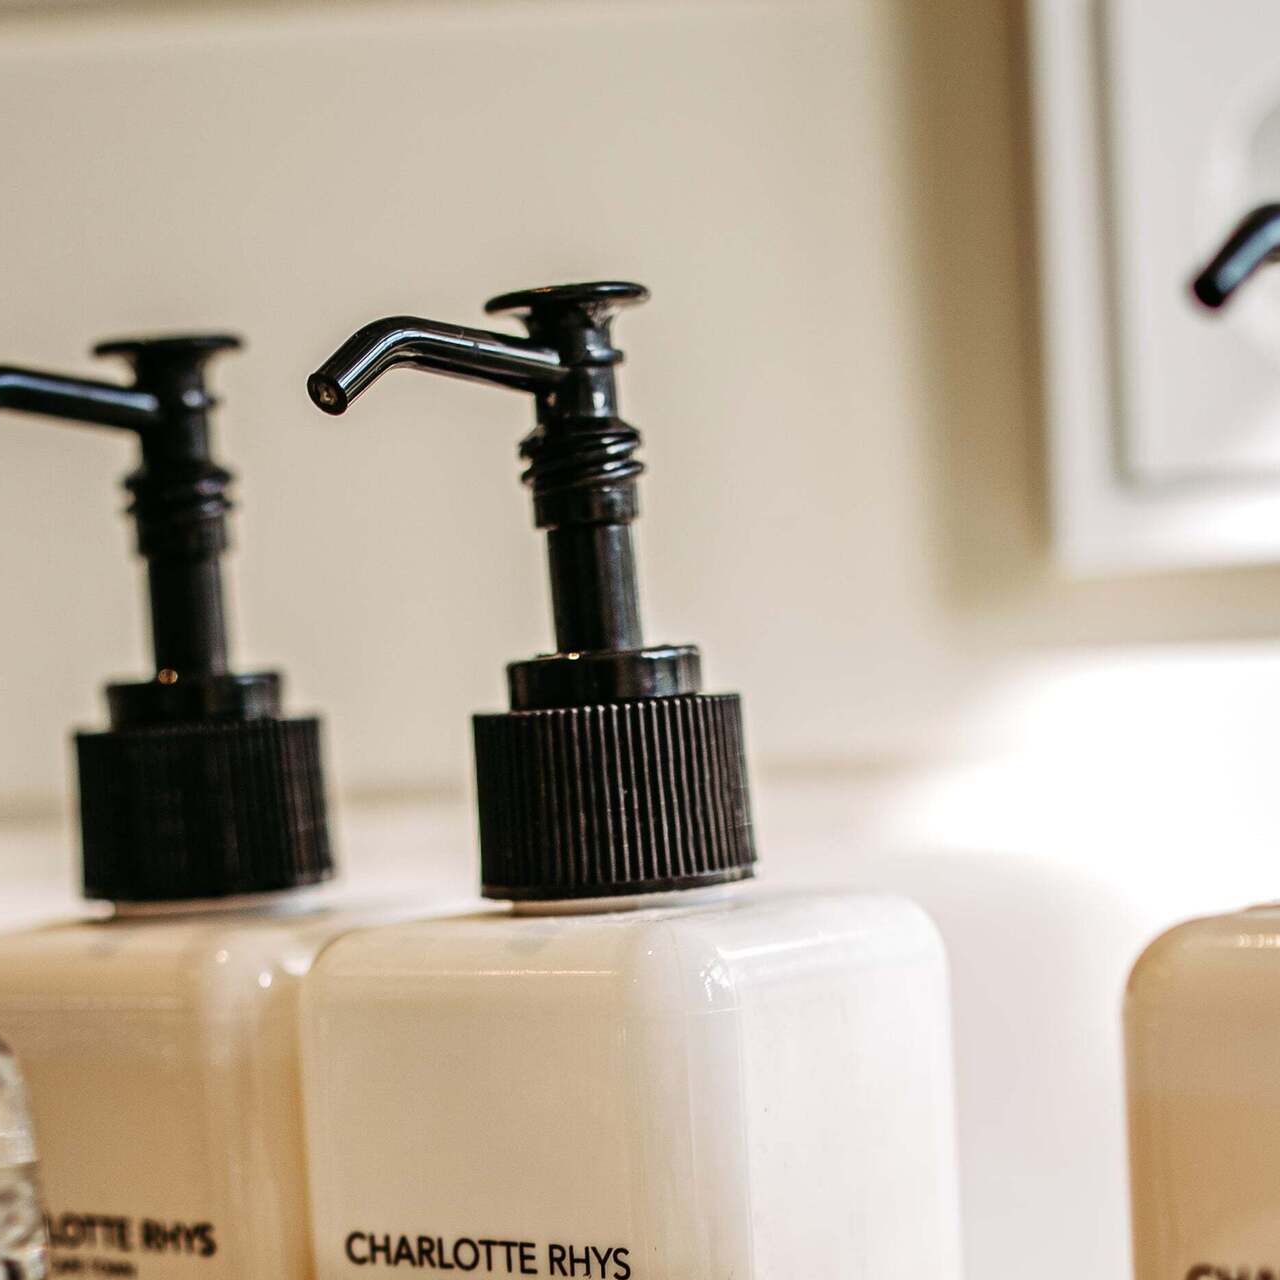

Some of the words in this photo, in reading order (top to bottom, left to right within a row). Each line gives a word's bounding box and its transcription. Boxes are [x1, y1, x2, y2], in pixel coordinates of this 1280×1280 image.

[43, 1213, 132, 1252] LOTTE
[141, 1217, 217, 1256] RHYS
[345, 1232, 538, 1274] CHARLOTTE
[549, 1244, 631, 1280] RHYS
